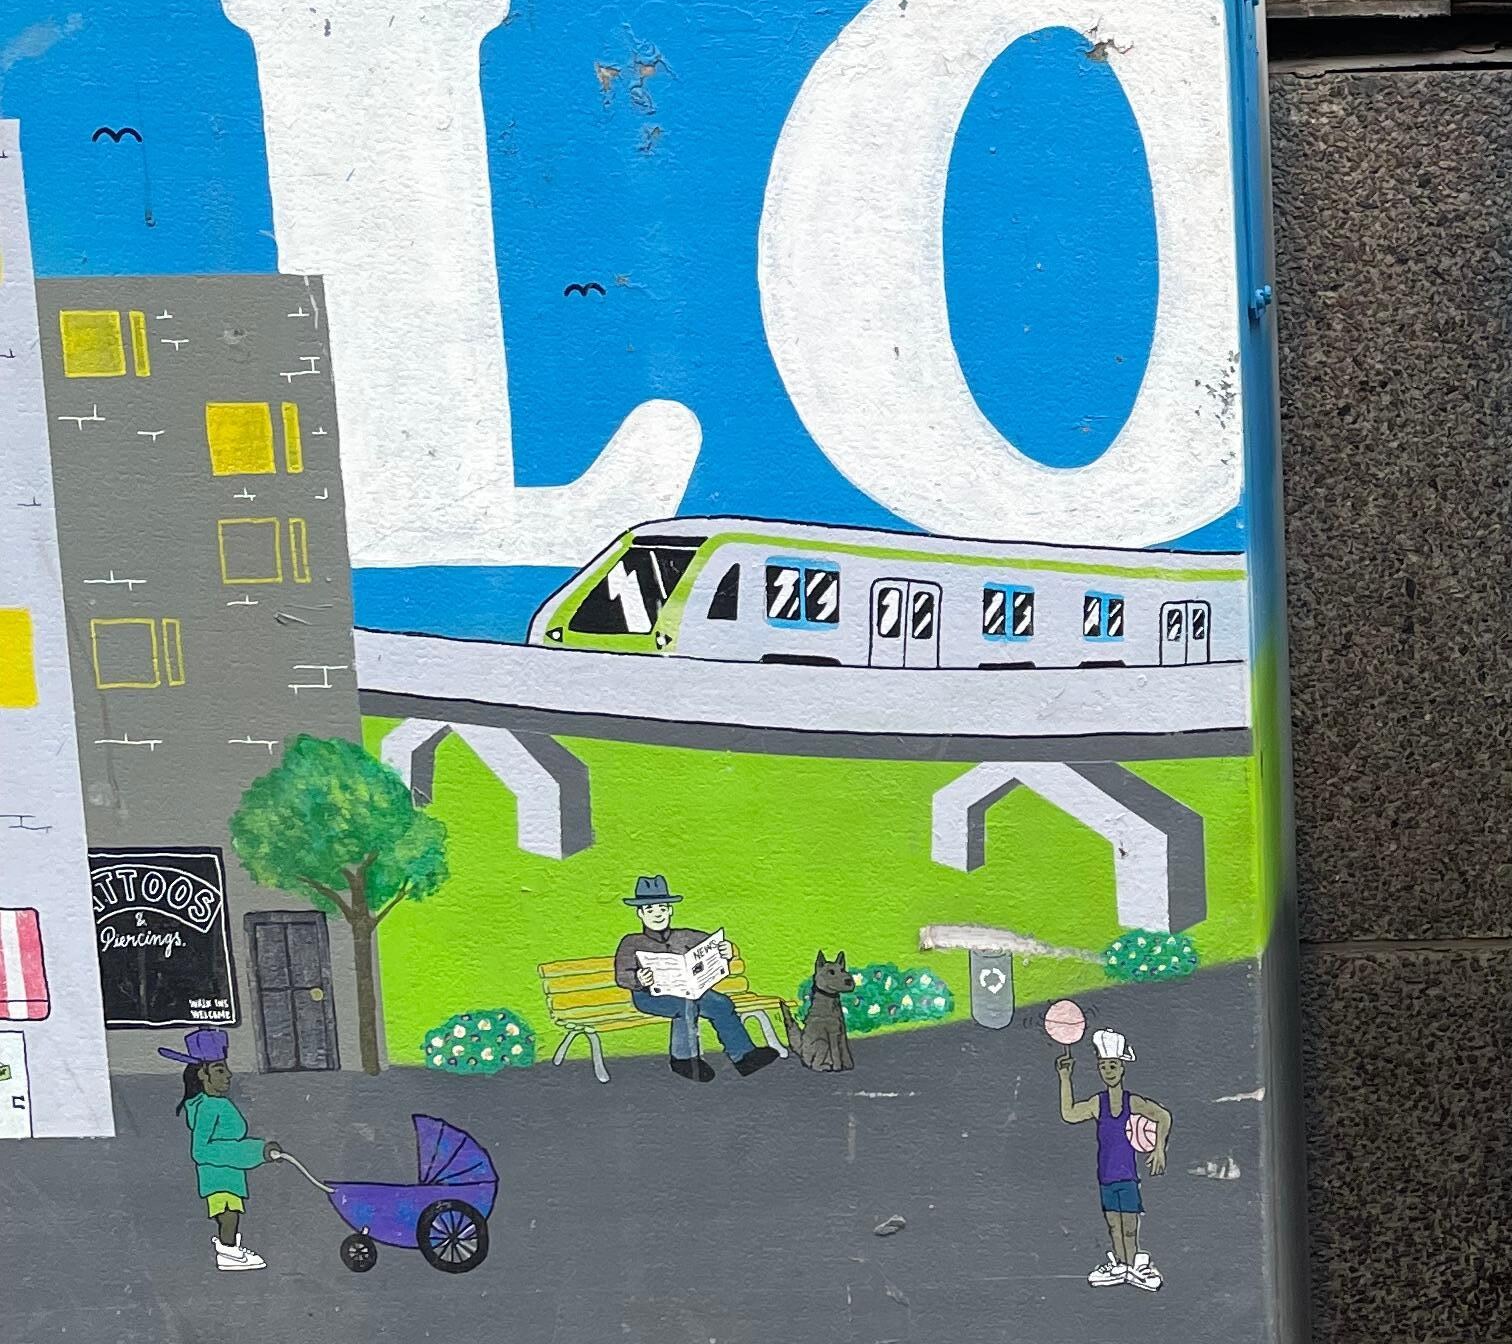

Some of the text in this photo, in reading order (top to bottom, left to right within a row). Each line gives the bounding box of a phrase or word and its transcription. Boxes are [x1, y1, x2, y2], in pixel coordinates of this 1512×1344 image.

[92, 869, 215, 923] TTOOS
[134, 911, 148, 927] &
[693, 939, 718, 960] NEWS
[190, 1009, 231, 1020] WELCOME
